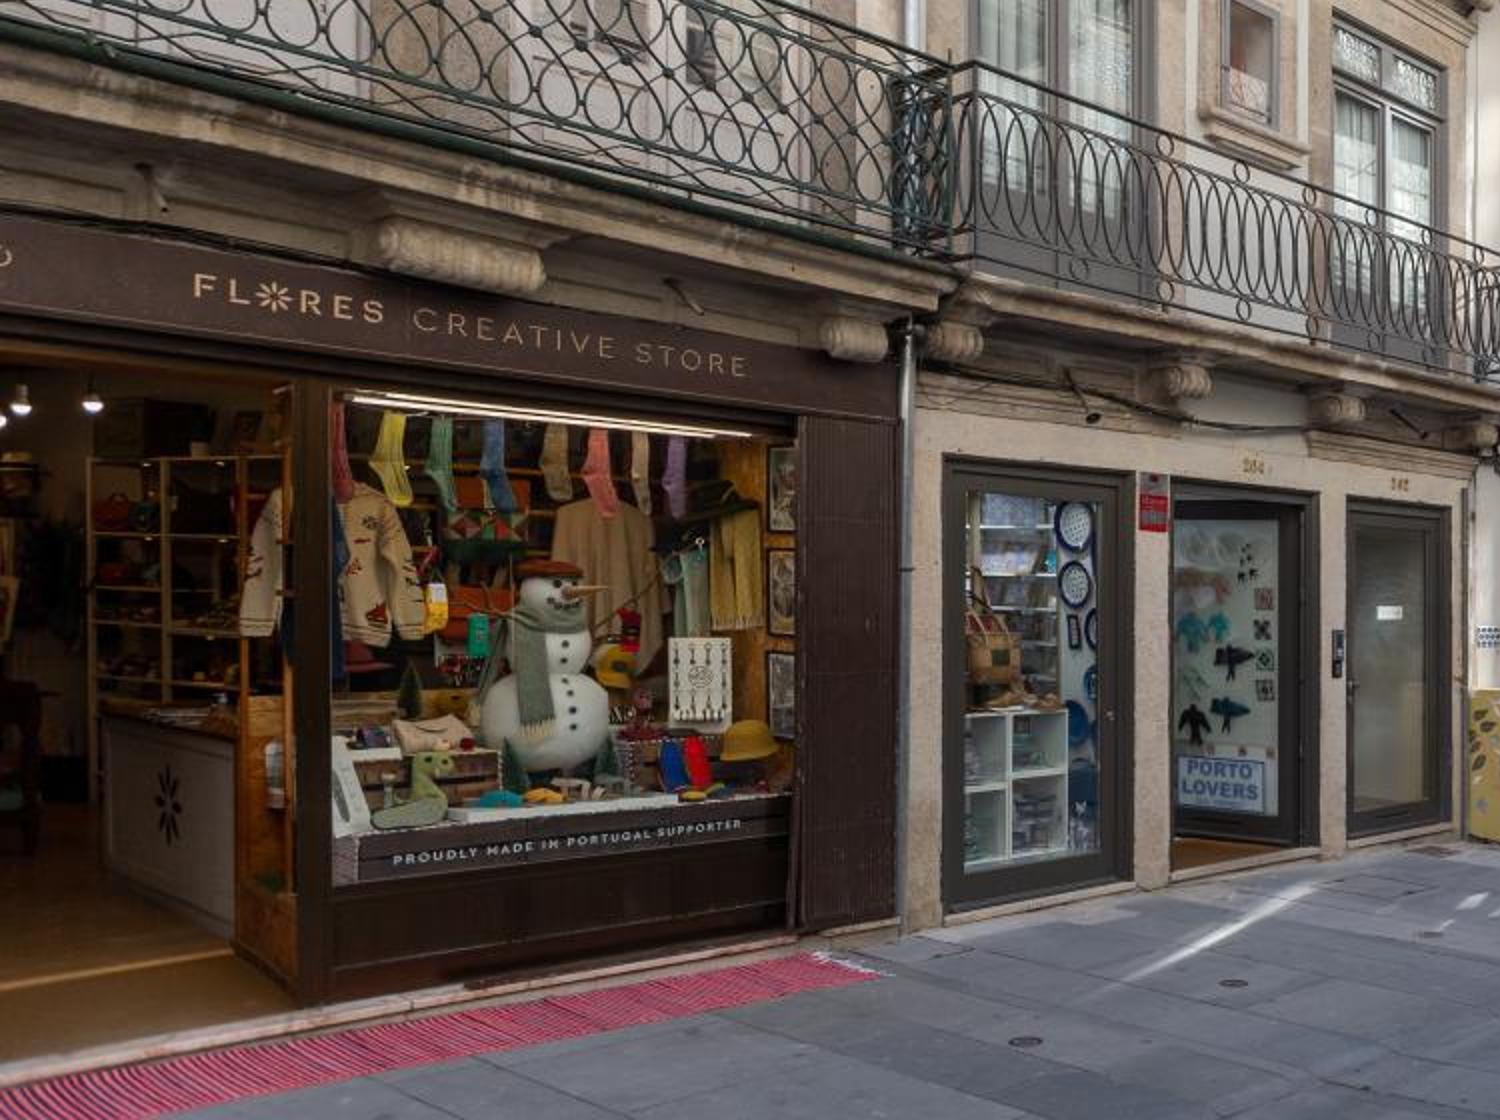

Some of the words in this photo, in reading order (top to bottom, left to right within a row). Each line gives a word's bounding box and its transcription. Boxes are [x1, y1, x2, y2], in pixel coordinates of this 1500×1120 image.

[413, 307, 616, 359] CREATIVE
[635, 342, 747, 379] STORE
[1186, 759, 1252, 780] PORTO
[1183, 779, 1258, 801] LOVERS
[393, 847, 478, 866] PROUDLY
[486, 841, 535, 857] MADE
[567, 830, 653, 848] PORTUGAL
[657, 819, 742, 838] SUPPORTER
